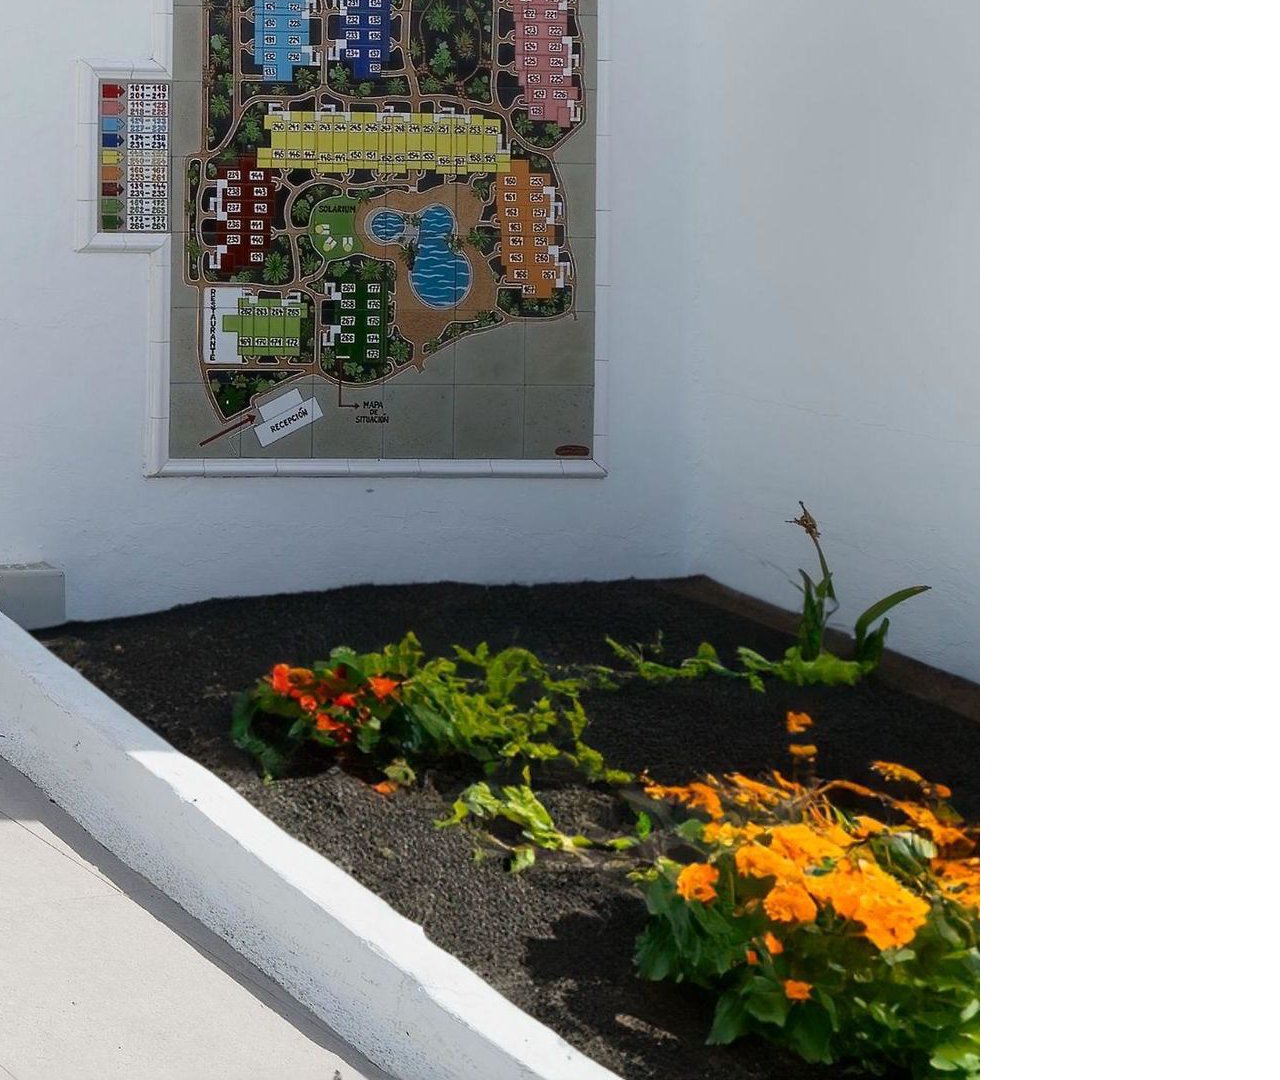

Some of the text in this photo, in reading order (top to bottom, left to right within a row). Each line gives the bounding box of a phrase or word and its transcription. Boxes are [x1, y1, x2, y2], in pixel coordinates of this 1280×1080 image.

[318, 205, 356, 213] SOLARIUM
[362, 401, 384, 409] MAPA
[270, 407, 309, 433] RECEPCIÓN
[355, 413, 389, 424] SITUACIÓN
